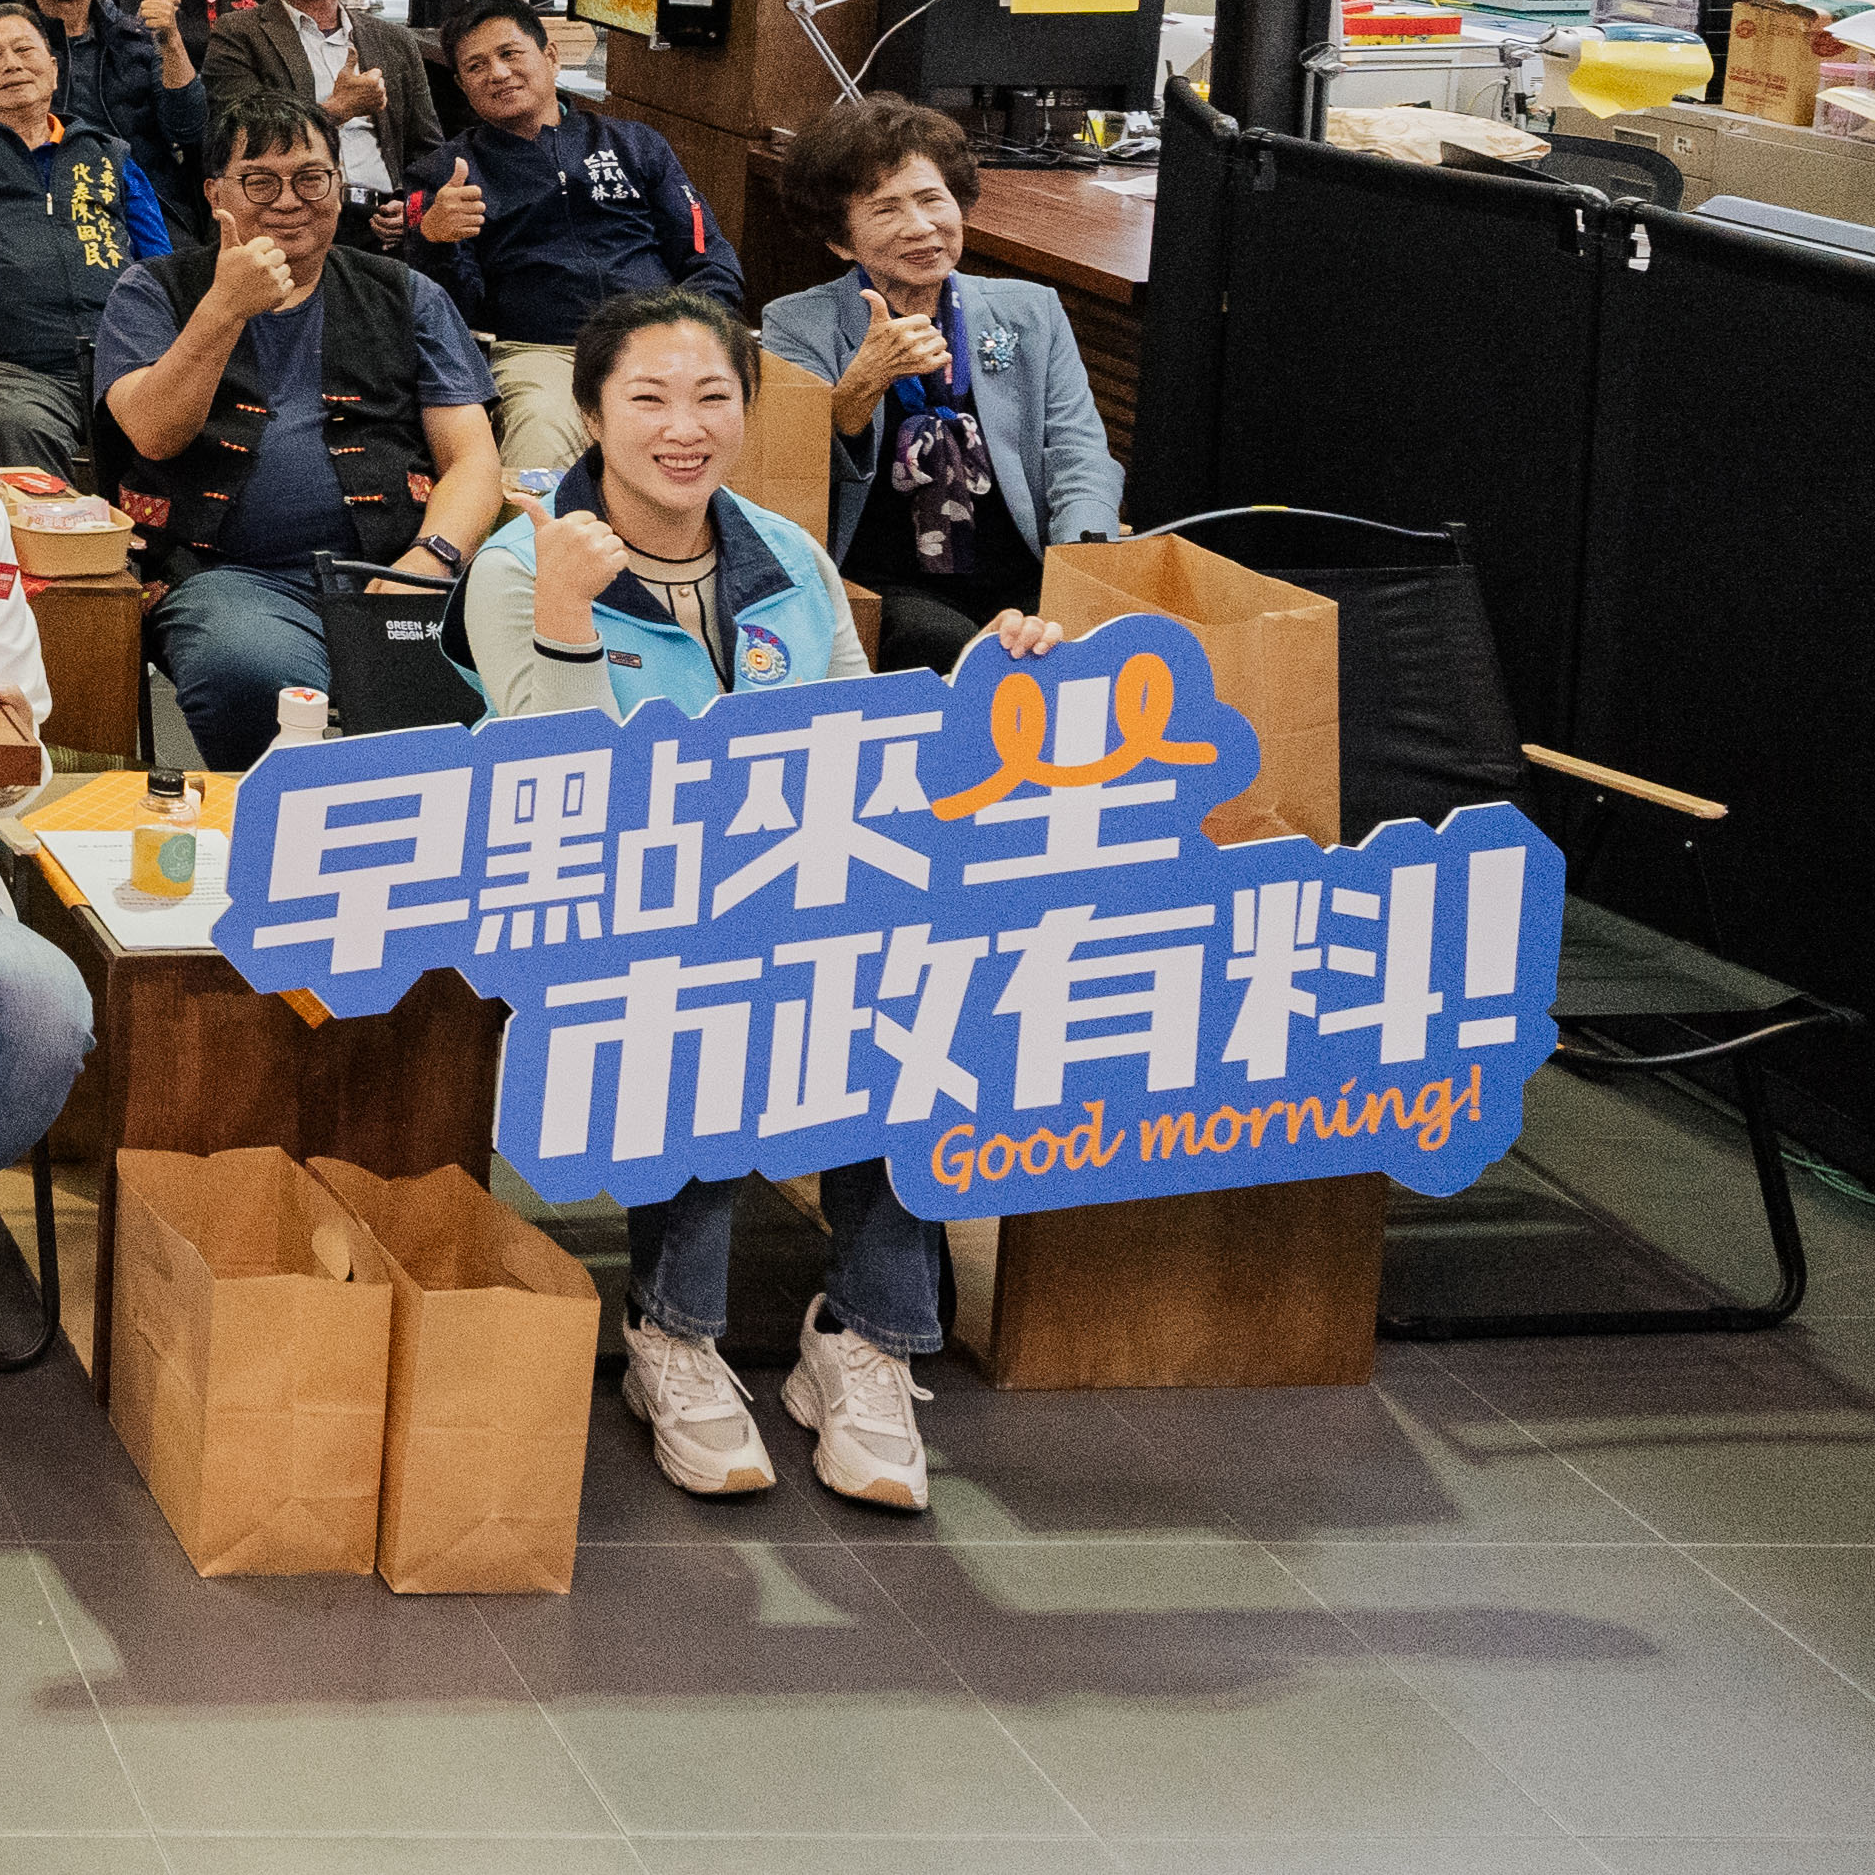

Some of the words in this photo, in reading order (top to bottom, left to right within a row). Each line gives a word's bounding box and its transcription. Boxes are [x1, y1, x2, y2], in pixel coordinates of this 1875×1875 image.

[591, 182, 642, 201] 林志
[384, 619, 423, 633] GREEN
[387, 628, 425, 642] DESIGN
[253, 652, 1217, 975] 早點來坐
[538, 844, 1528, 1163] 市政有料!
[928, 1100, 1126, 1195] Good
[1136, 1063, 1488, 1166] morning!
